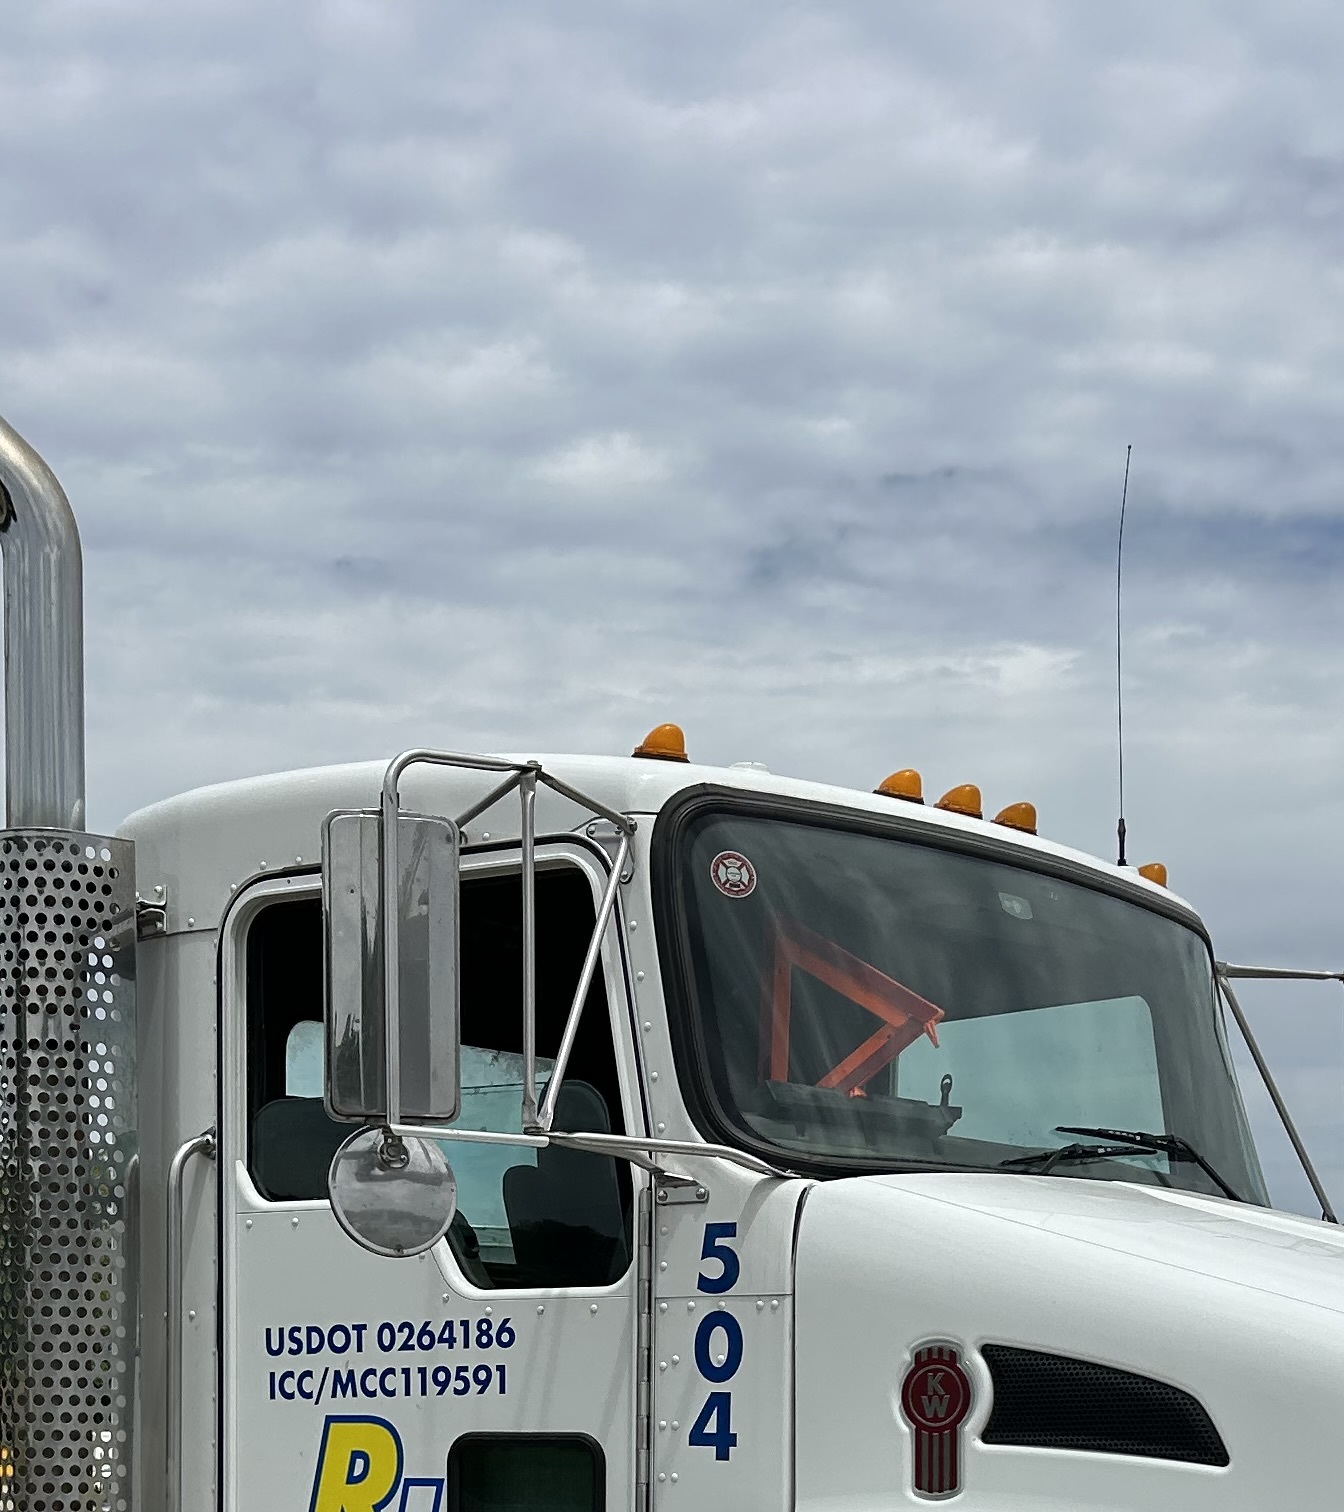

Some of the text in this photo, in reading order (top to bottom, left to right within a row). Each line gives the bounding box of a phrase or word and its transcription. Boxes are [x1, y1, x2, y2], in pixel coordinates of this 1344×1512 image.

[265, 1318, 516, 1356] USDOT 0264186
[688, 1222, 744, 1461] 504
[269, 1364, 506, 1405] ICC/MCC119591
